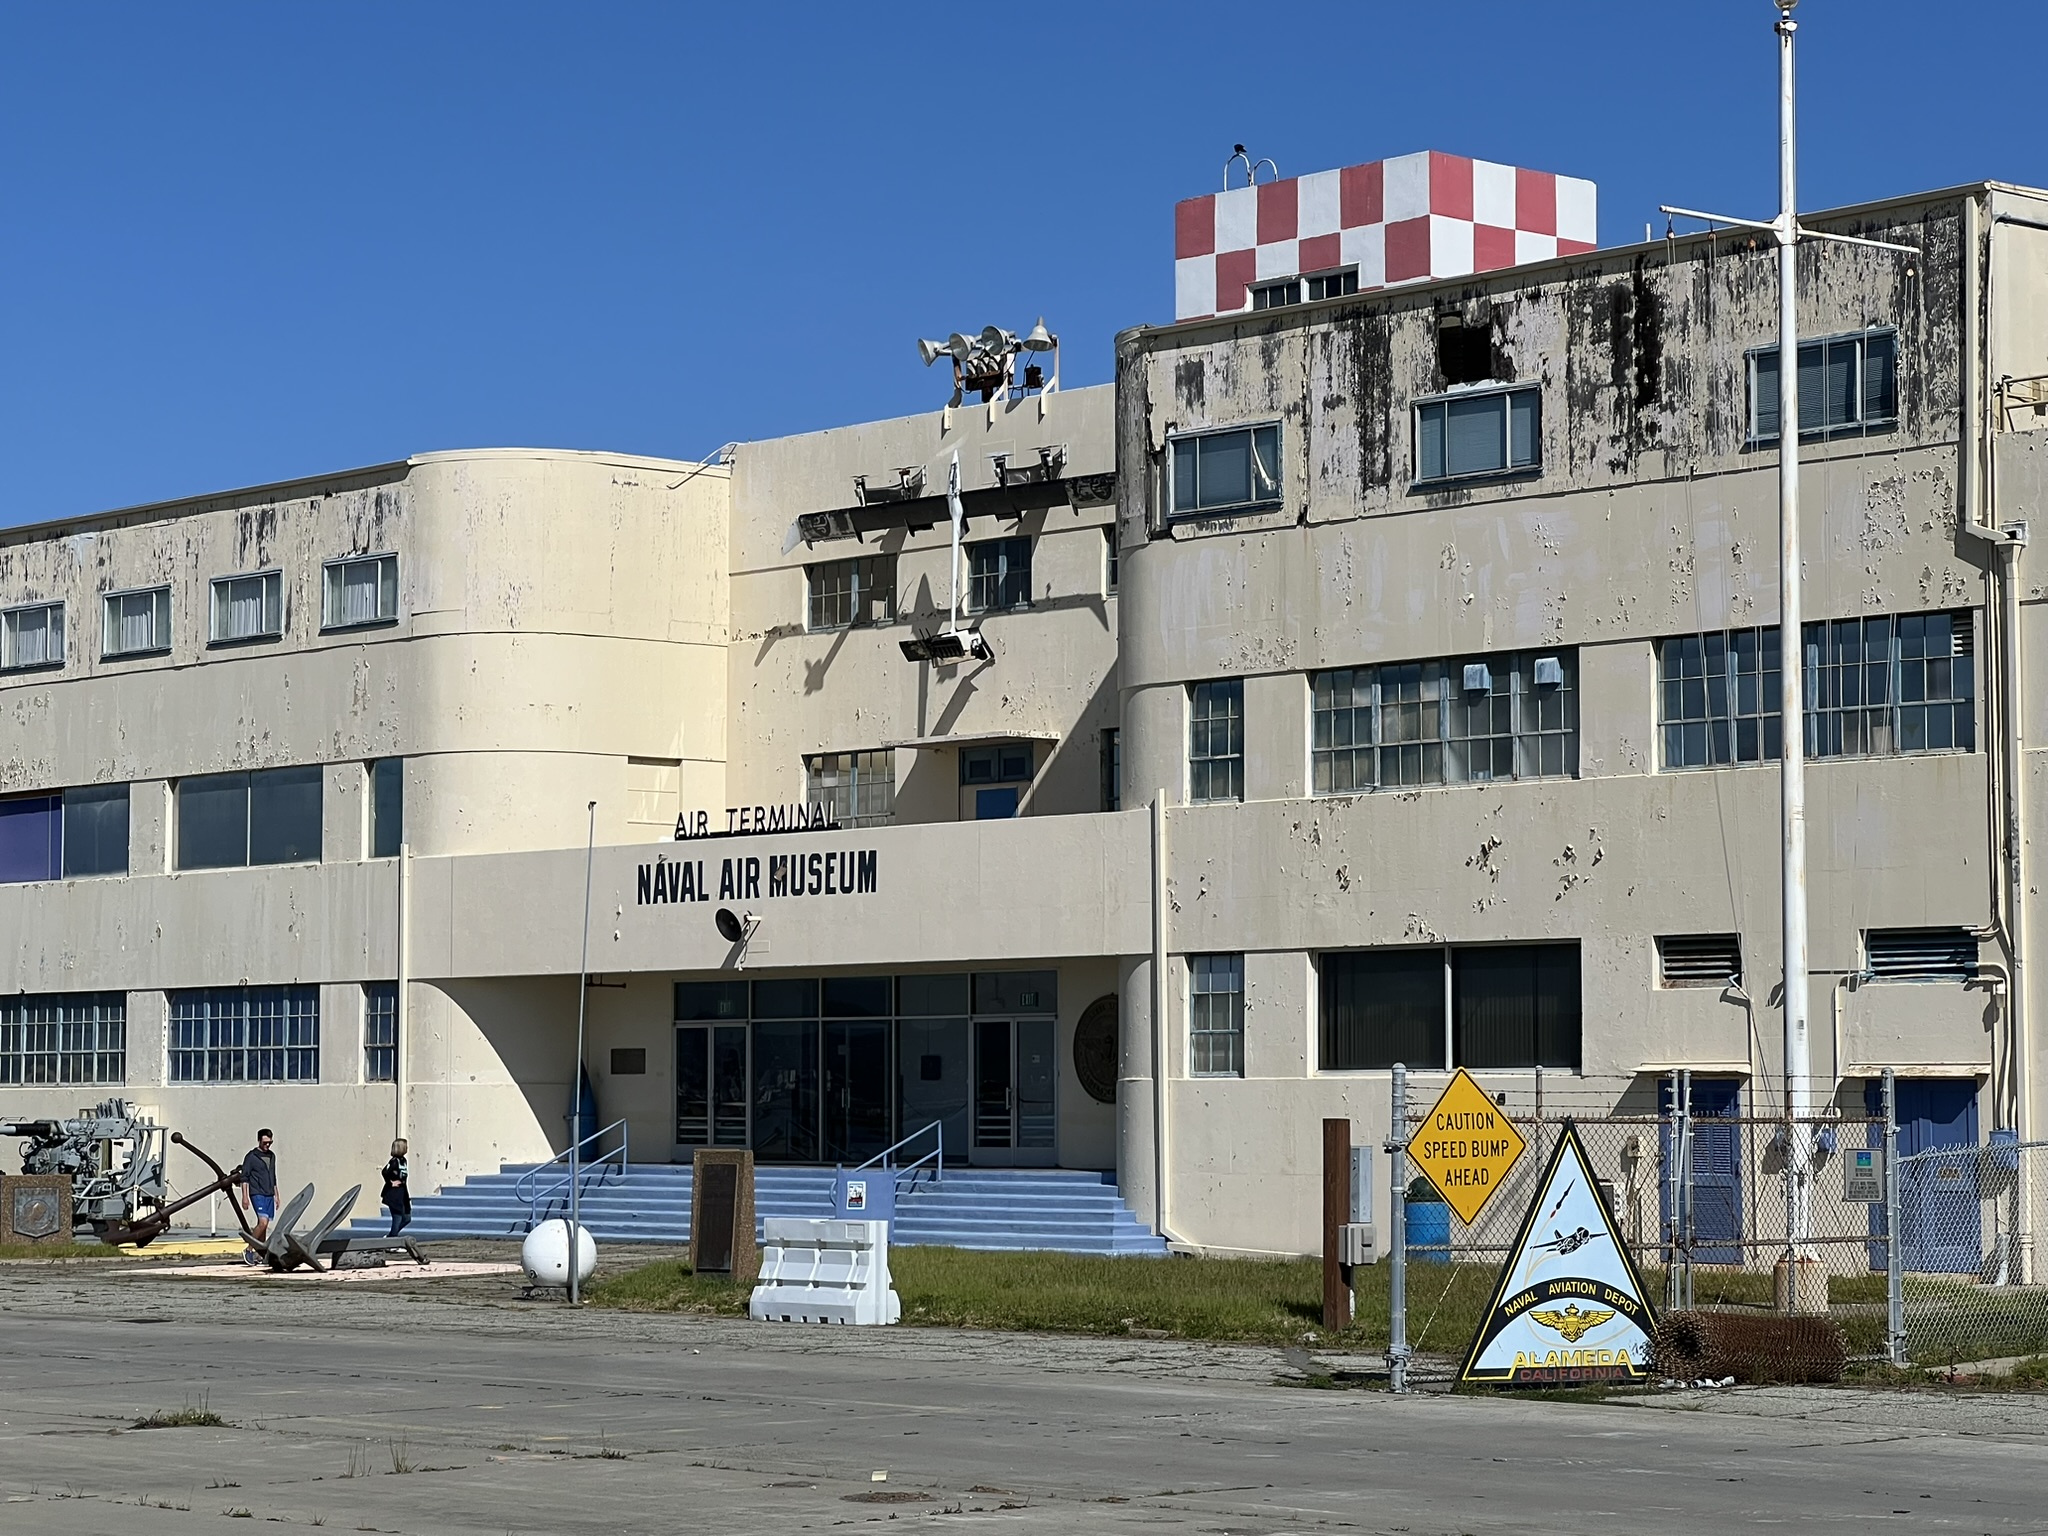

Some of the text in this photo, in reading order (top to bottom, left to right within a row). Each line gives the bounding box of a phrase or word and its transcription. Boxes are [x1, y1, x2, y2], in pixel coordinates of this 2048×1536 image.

[675, 800, 841, 838] AIR TERMINAL
[637, 850, 877, 905] NAVAL AIR MUSEUM
[1436, 1112, 1495, 1131] CAUTION
[1423, 1140, 1509, 1160] SPEED BUMP
[1445, 1168, 1489, 1187] AHEAD
[1504, 1281, 1639, 1317] NAVAL AVIATION DEPOT
[1513, 1349, 1632, 1368] ALAMEDA
[1520, 1366, 1625, 1381] CALIFORNIA
